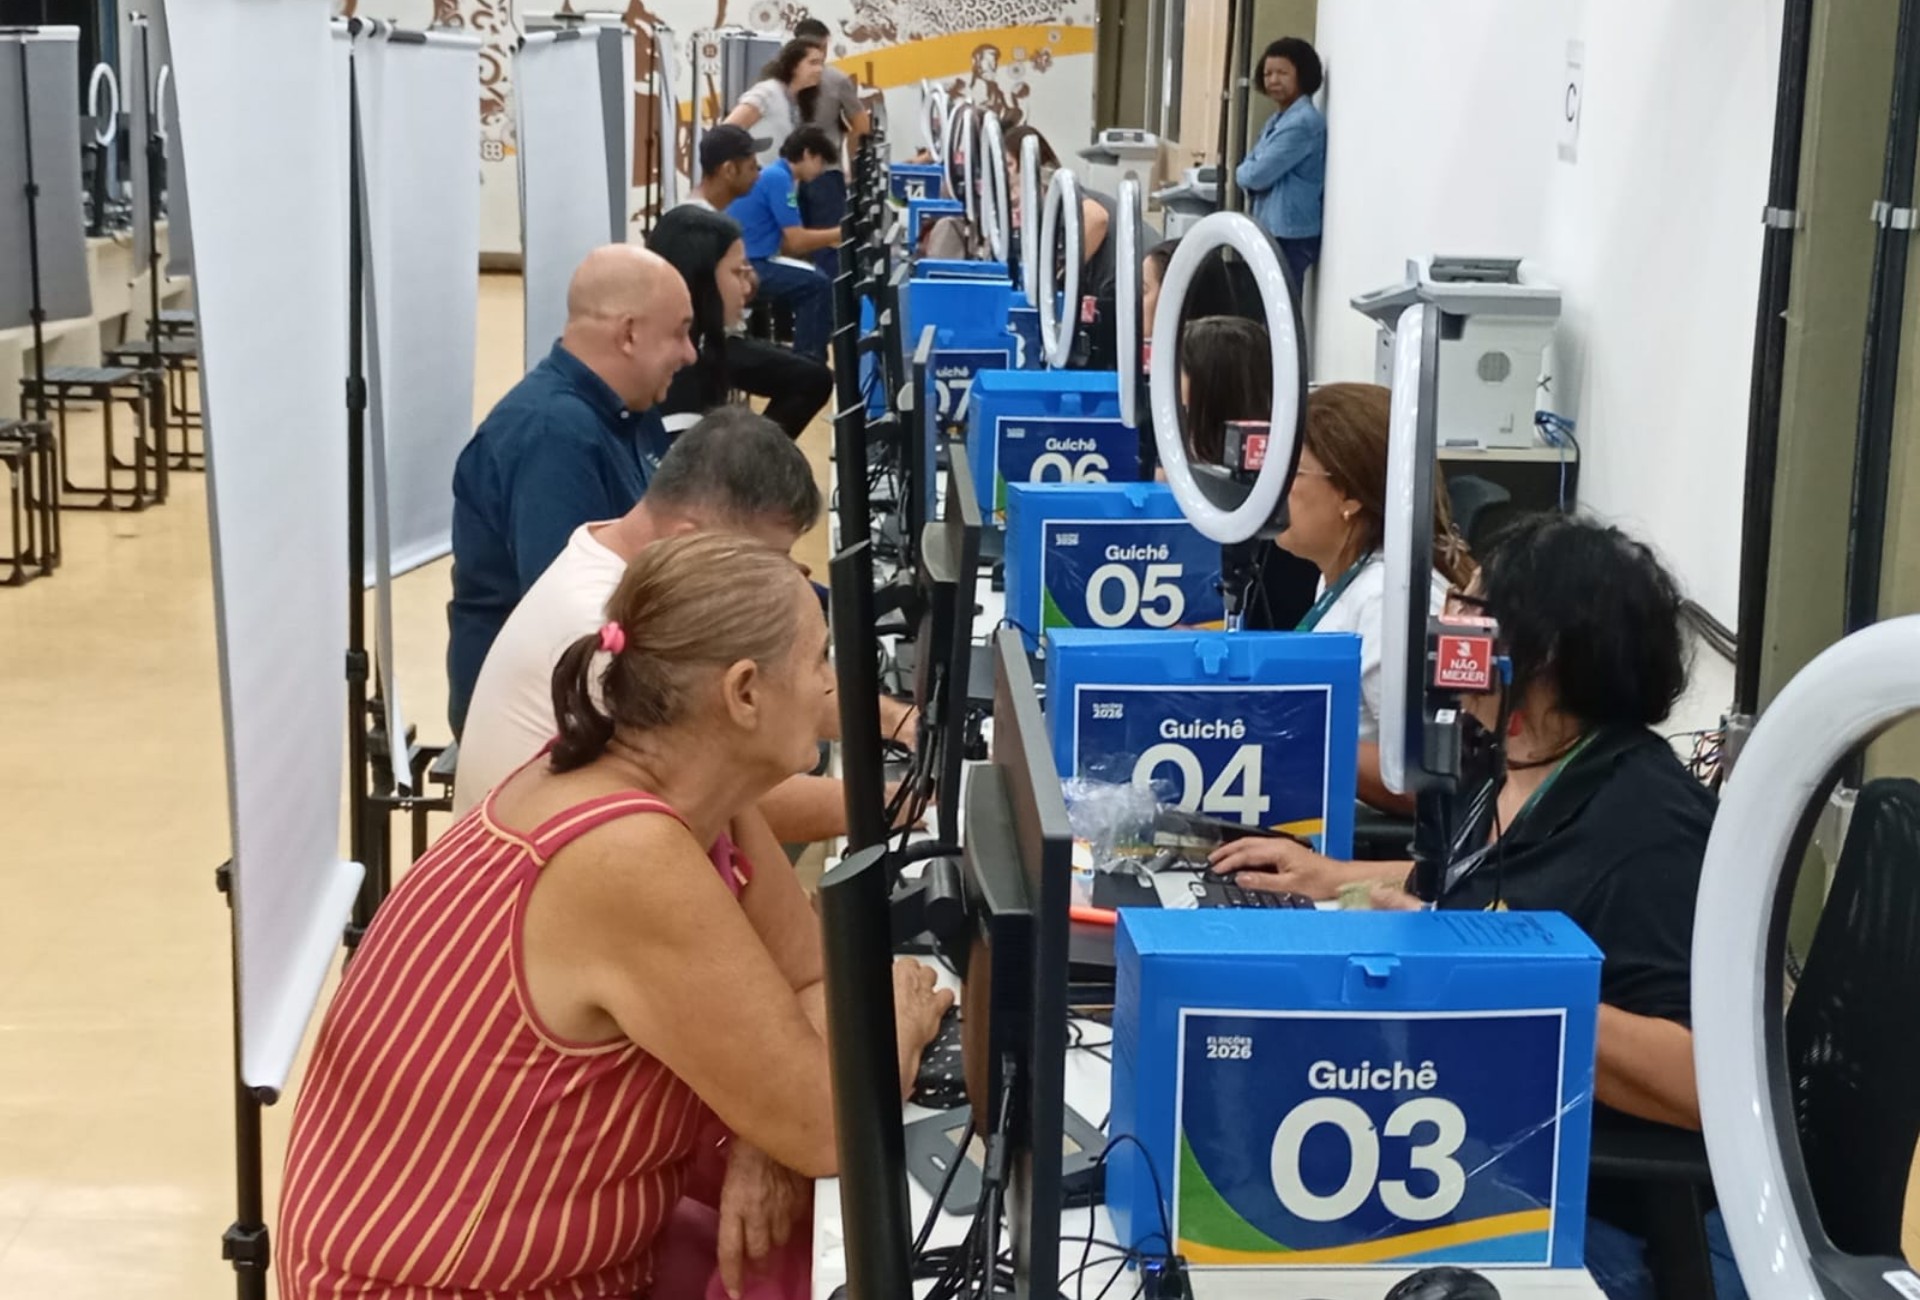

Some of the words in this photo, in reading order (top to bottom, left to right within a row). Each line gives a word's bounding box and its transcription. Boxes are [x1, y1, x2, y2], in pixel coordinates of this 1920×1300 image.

[1030, 452, 1109, 483] 06
[1105, 544, 1169, 561] Guichê
[1086, 563, 1185, 628] 05
[1159, 717, 1246, 739] Guichê
[1132, 742, 1270, 826] 04
[1207, 1044, 1253, 1059] 2026
[1308, 1060, 1438, 1090] Guichê
[1271, 1096, 1467, 1222] 03
